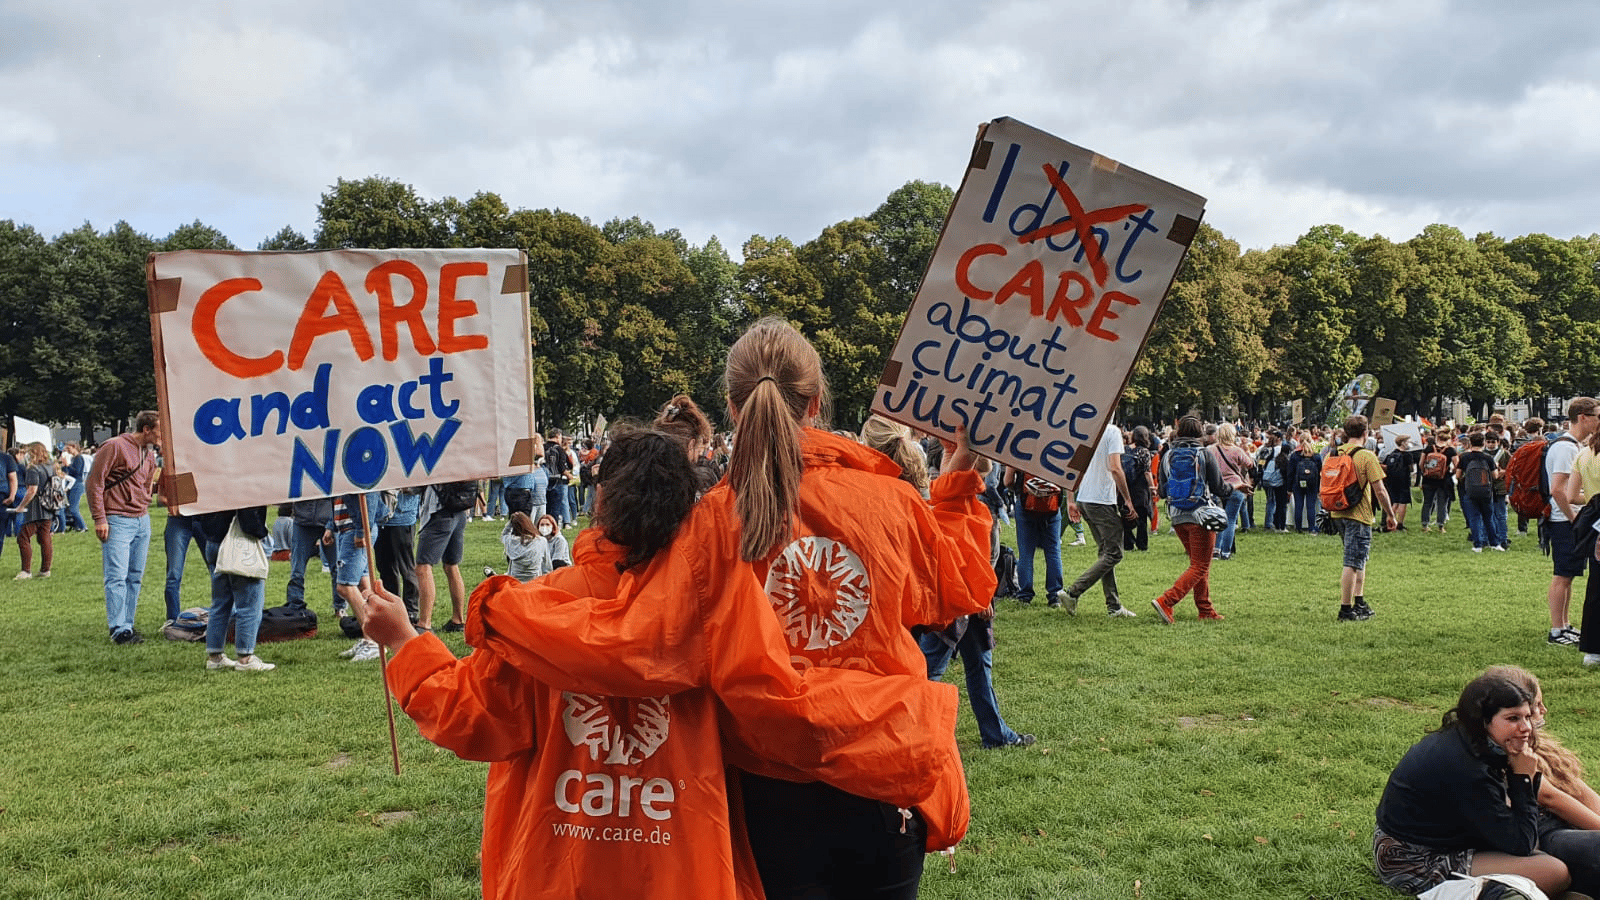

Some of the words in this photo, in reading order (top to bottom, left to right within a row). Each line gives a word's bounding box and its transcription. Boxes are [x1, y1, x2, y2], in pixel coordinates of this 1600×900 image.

[983, 143, 1021, 223] I
[1008, 161, 1159, 283] don't
[192, 260, 488, 379] CARE
[927, 297, 1067, 375] about
[955, 243, 1141, 342] CARE
[193, 363, 333, 445] and
[356, 357, 460, 424] act
[883, 370, 1076, 481] justice.
[288, 418, 462, 499] NOW
[552, 823, 671, 846] www.care.de
[554, 769, 675, 821] care
